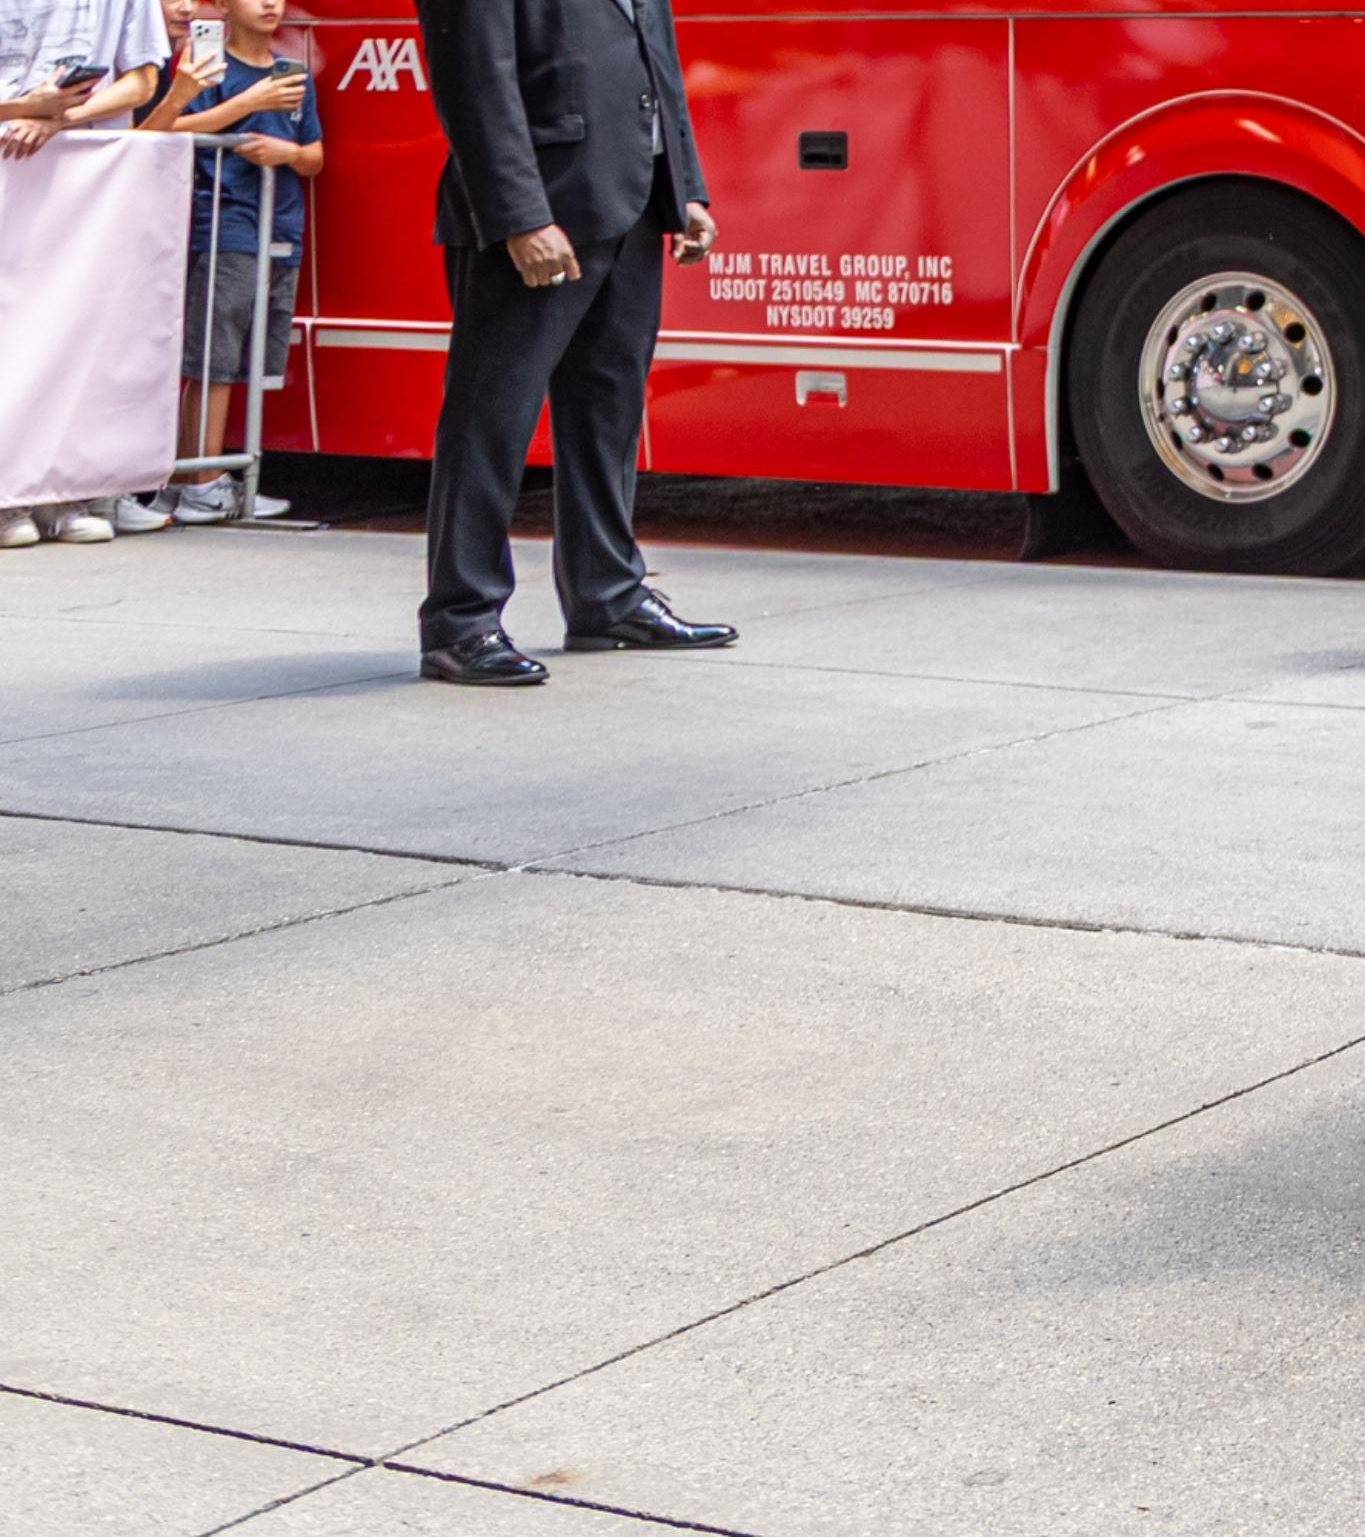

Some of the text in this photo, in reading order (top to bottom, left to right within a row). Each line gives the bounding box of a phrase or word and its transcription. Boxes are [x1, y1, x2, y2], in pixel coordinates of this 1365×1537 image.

[336, 37, 429, 92] AXA
[709, 253, 953, 280] MJM TRAVEL GROUP, INC
[709, 279, 953, 305] USDOT 2510549 MC 870716
[766, 305, 895, 330] NYSDOT 39259
